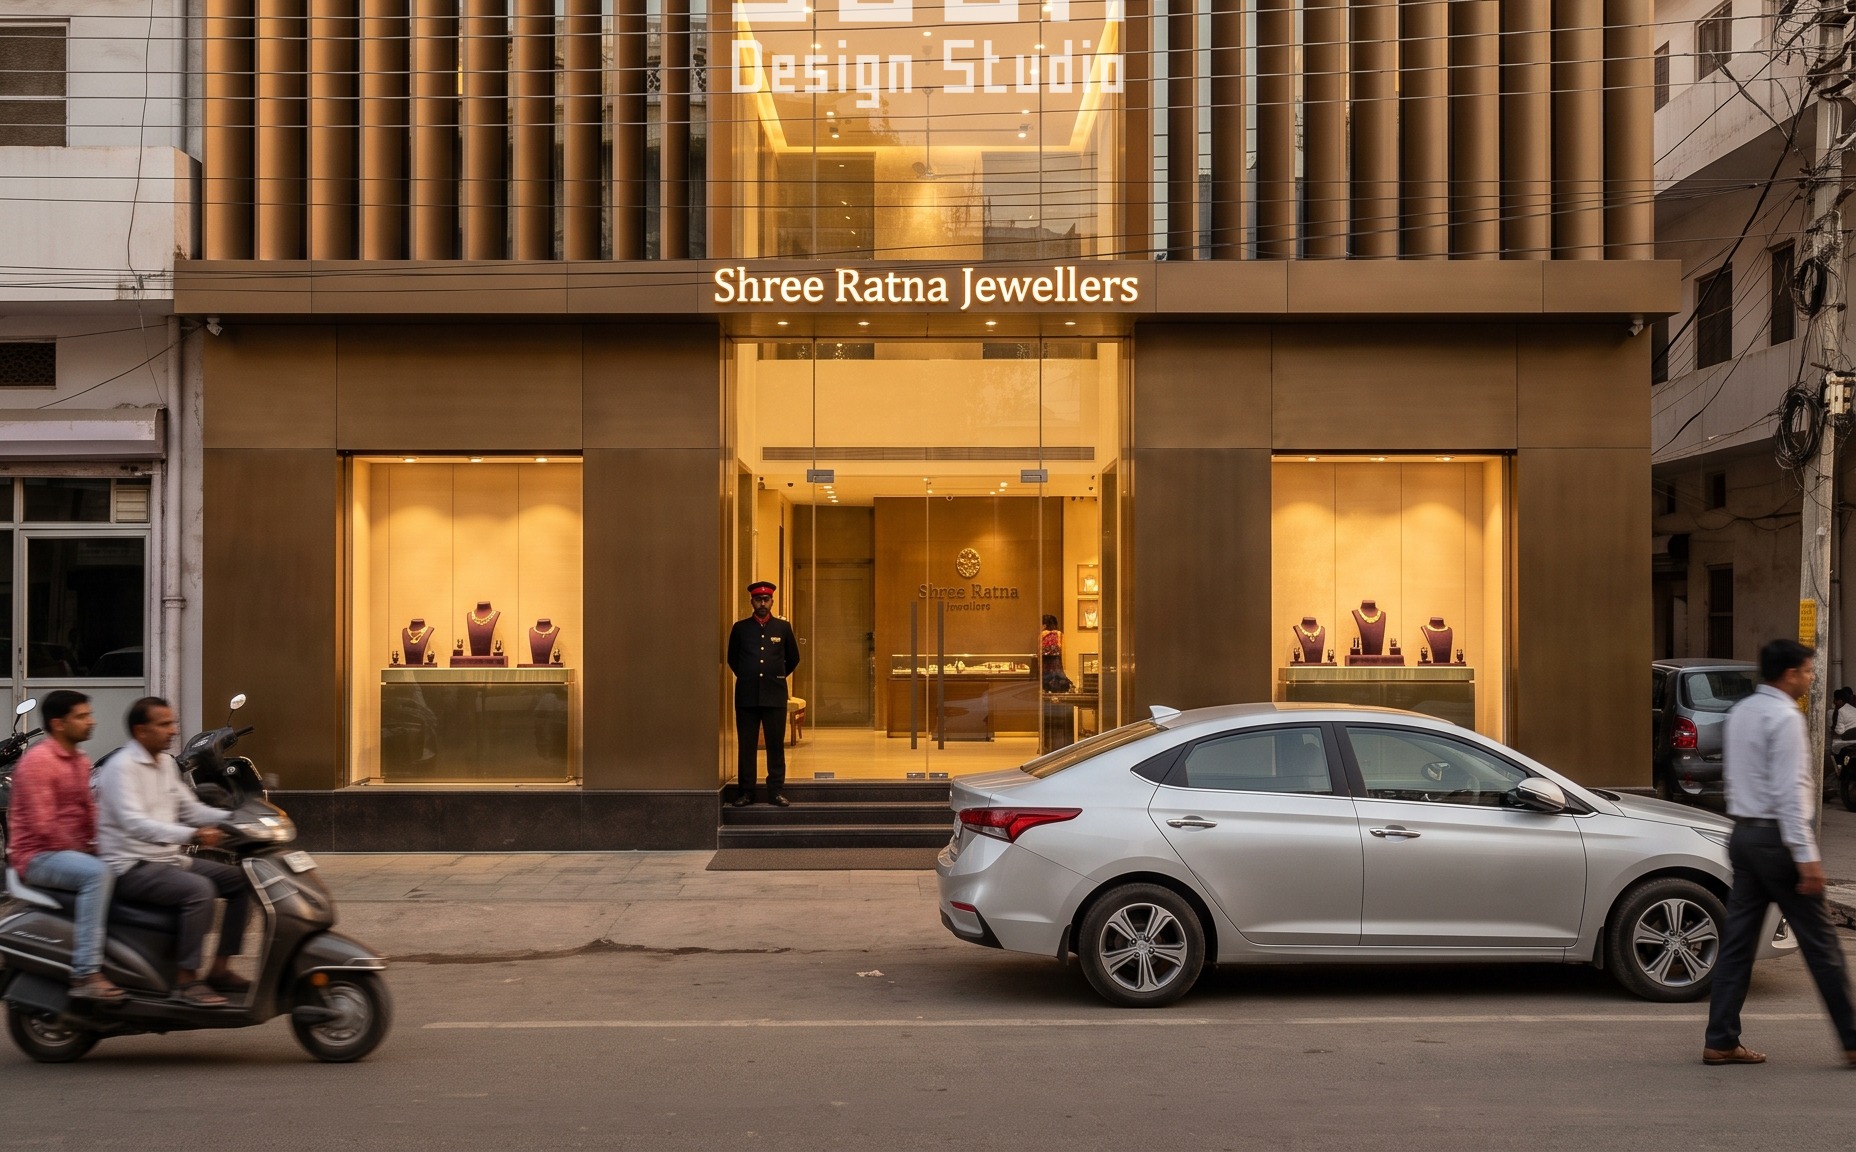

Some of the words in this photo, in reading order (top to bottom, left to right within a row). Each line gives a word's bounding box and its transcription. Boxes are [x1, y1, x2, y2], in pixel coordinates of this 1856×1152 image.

[714, 266, 825, 304] Shree
[835, 268, 949, 304] Ratna
[961, 266, 1139, 310] Jewellers
[919, 583, 966, 599] Shree
[971, 584, 1019, 599] Ratna
